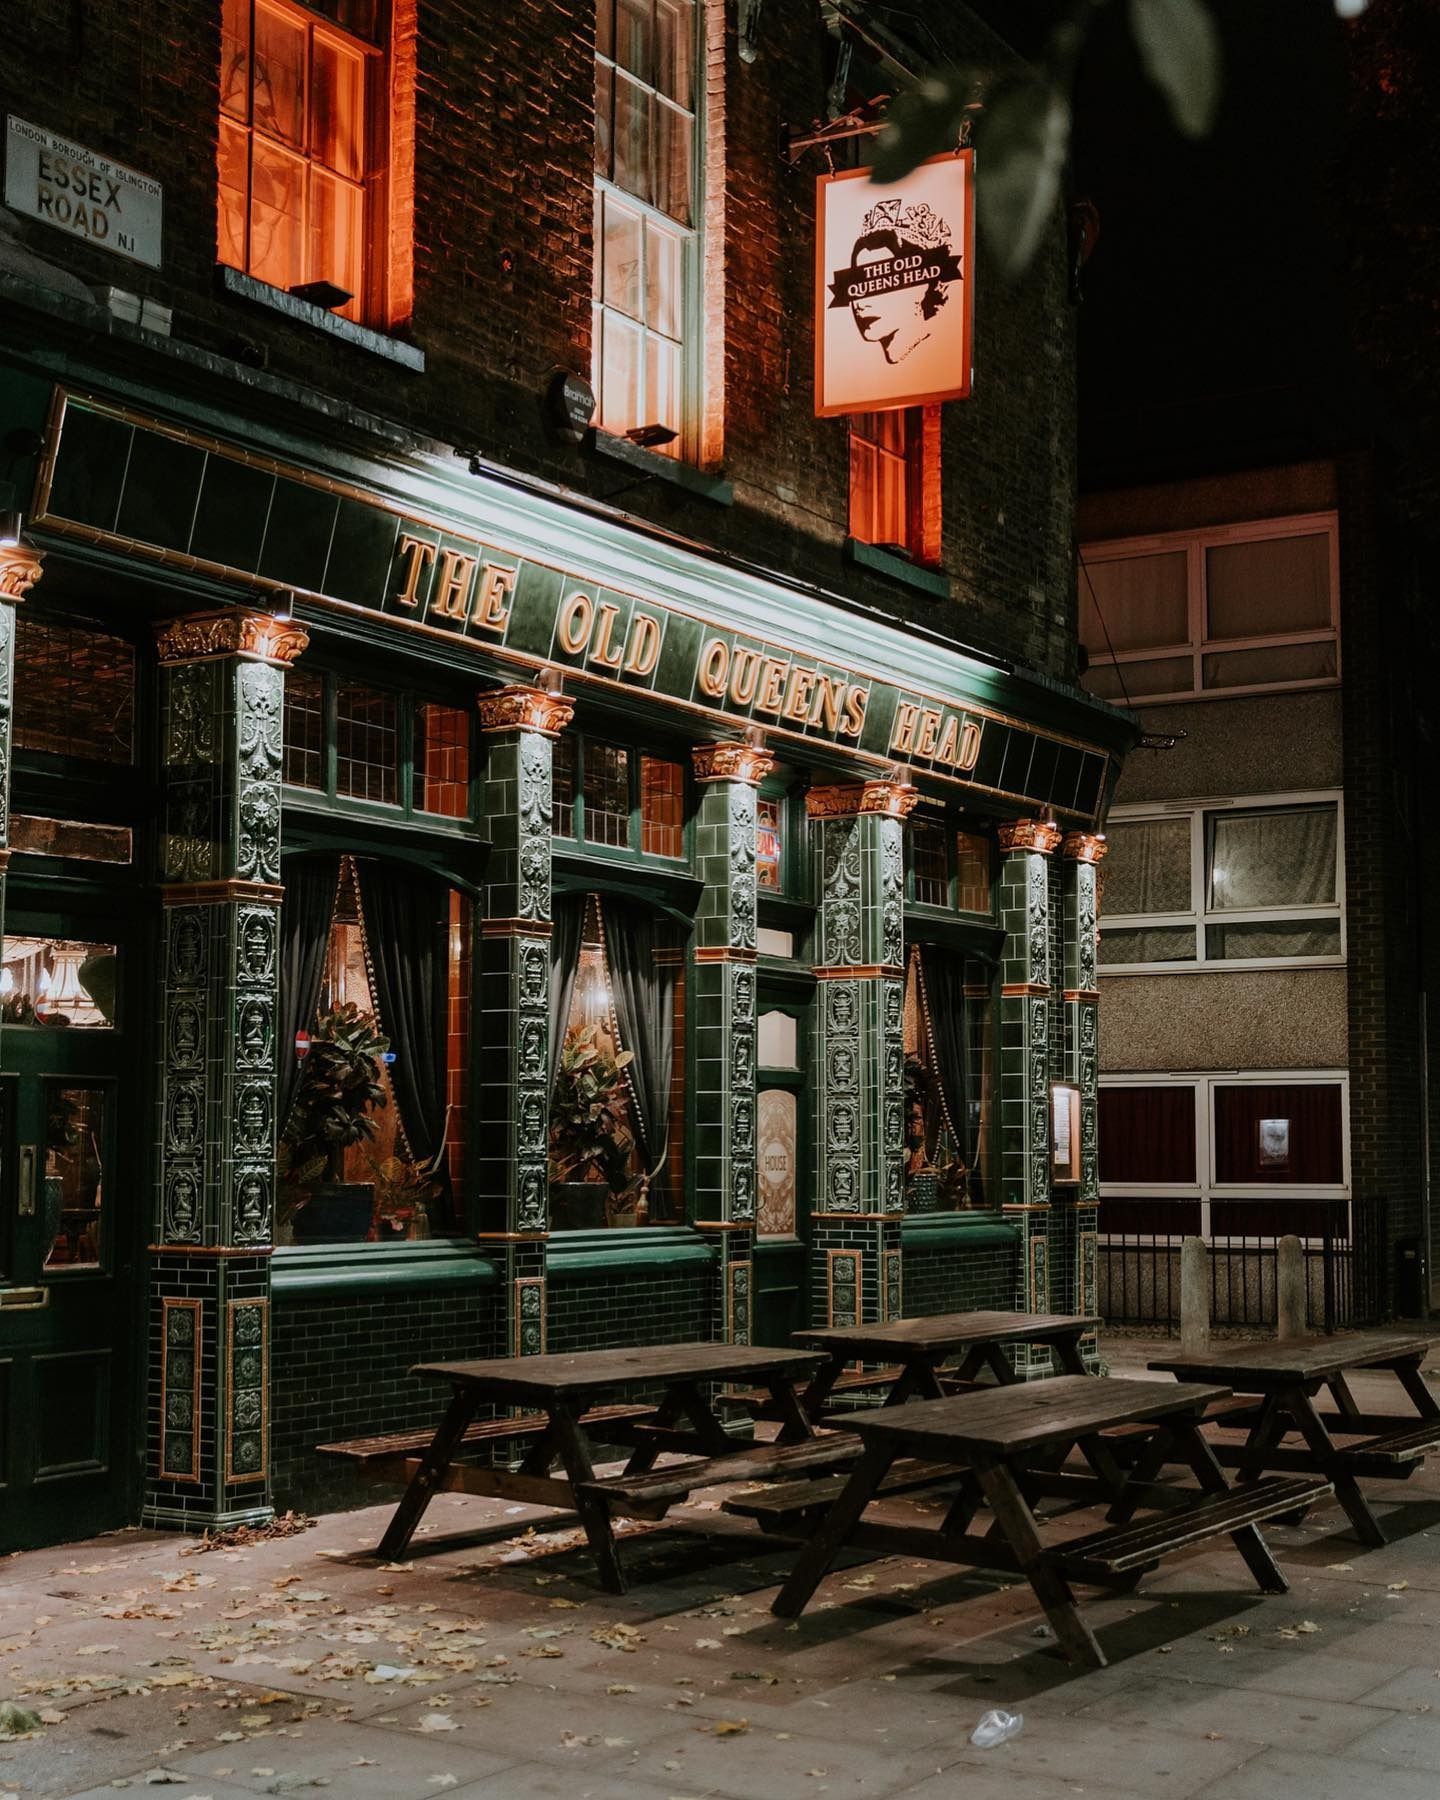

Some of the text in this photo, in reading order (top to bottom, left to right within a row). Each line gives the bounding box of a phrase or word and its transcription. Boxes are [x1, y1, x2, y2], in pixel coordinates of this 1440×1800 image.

[9, 119, 161, 197] LONDON BOROUGH OF ISLINGTON
[38, 150, 122, 214] ESSEX
[37, 181, 109, 239] ROAD
[847, 264, 941, 298] QUEENS HEAD
[863, 254, 923, 279] THE OLD
[397, 531, 983, 773] THE OLD QUEENS HEAD
[764, 1155, 786, 1171] HOUSE
